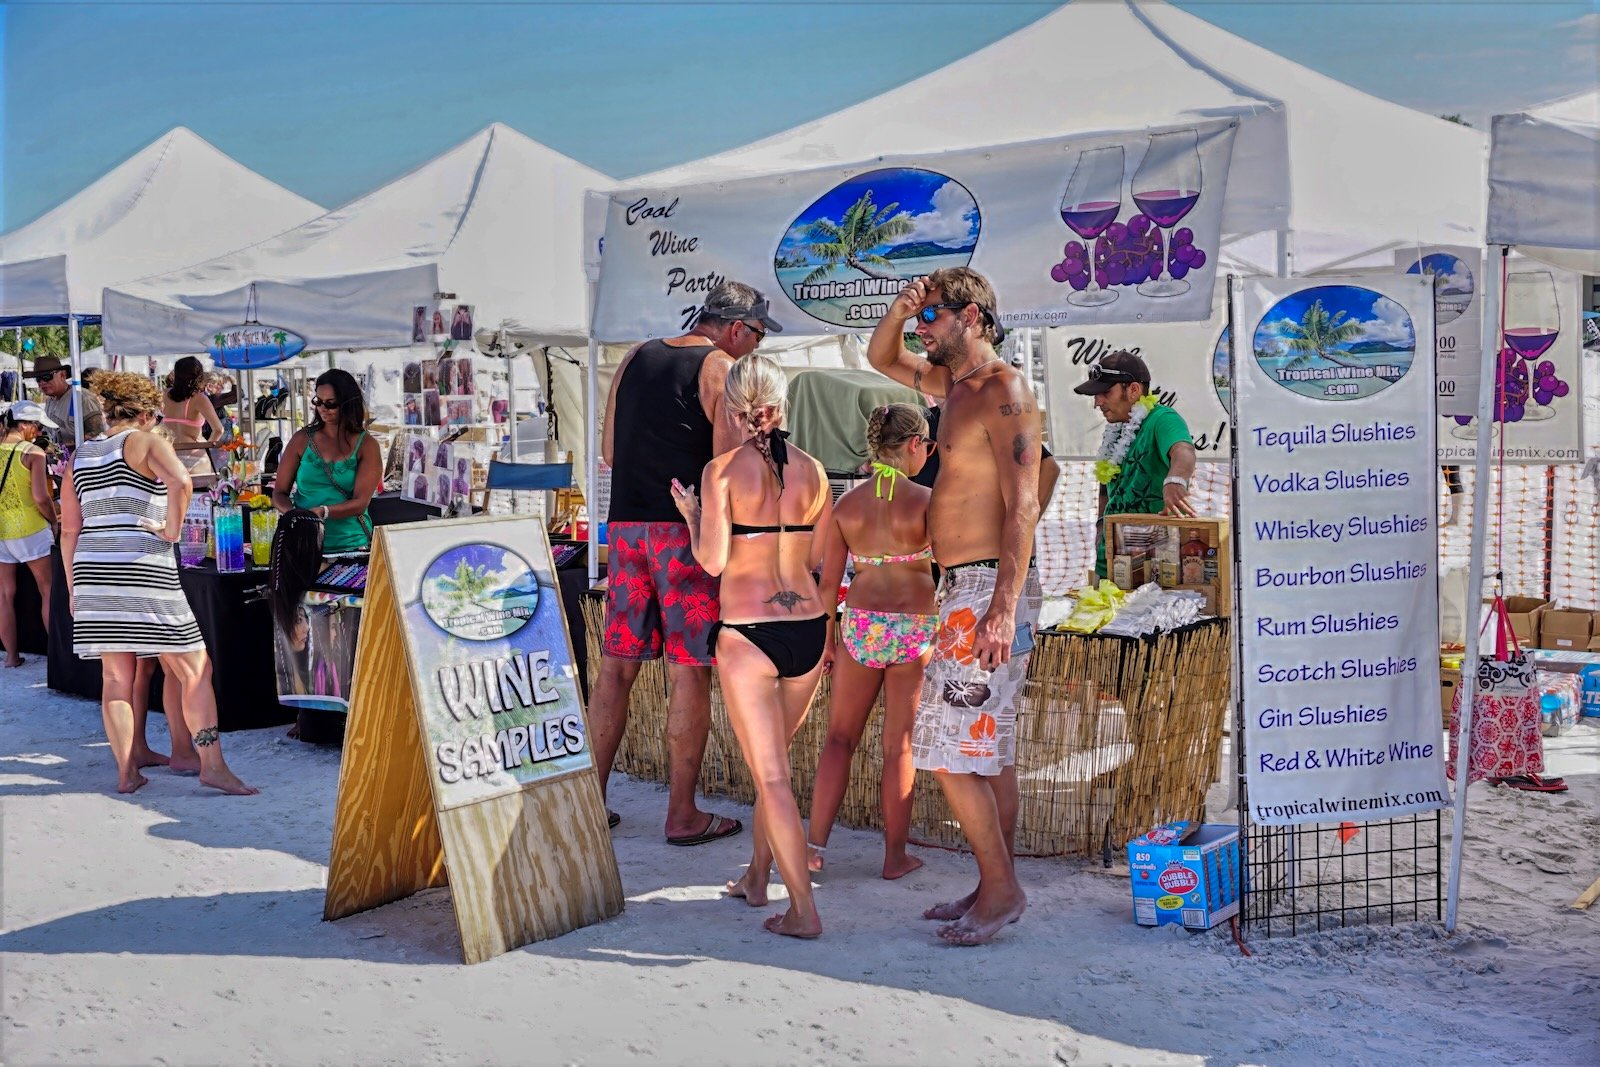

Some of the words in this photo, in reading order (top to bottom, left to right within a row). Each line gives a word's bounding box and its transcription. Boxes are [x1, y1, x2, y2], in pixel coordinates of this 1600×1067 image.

[626, 197, 679, 226] Cool
[649, 230, 698, 257] Wine
[793, 279, 861, 301] Tropical
[863, 278, 909, 296] Wine
[846, 303, 888, 320] .com
[1067, 337, 1142, 365] Wi
[1437, 336, 1456, 349] 00
[1277, 367, 1334, 381] Tropical
[1335, 366, 1374, 379] Wine
[1375, 365, 1401, 378] Mix
[1324, 384, 1359, 396] .com
[1437, 380, 1456, 393] 00
[1253, 425, 1327, 453] Tequila
[1332, 422, 1416, 443] Slushies
[1437, 446, 1579, 459] opicainemix.com
[1253, 472, 1320, 494] Vodka
[1325, 468, 1409, 490] Slushies
[1255, 519, 1344, 543] Whiskey
[1348, 515, 1427, 536] Slushies
[1257, 567, 1345, 587] Bourbon
[1350, 560, 1427, 583] Slushies
[442, 612, 487, 629] Tropical
[487, 609, 512, 625] Wine
[512, 606, 531, 619] Mix
[1257, 617, 1306, 636] Rum
[1311, 612, 1399, 634] Slushies
[478, 625, 503, 637] .com
[1258, 661, 1335, 682] Scotch
[1341, 656, 1417, 679] Slushies
[438, 650, 560, 722] WINE
[1259, 709, 1293, 729] Gin
[1299, 704, 1388, 726] Slushies
[437, 715, 585, 784] SAMPLES
[1260, 752, 1299, 772] Red
[1305, 750, 1321, 769] &
[1326, 748, 1385, 767] White
[1389, 741, 1434, 761] Wine
[1257, 790, 1442, 820] tropicalwinemix.com
[1136, 853, 1150, 861] 850
[1161, 872, 1194, 882] DUBBLE
[1164, 879, 1196, 889] BUBBLE
